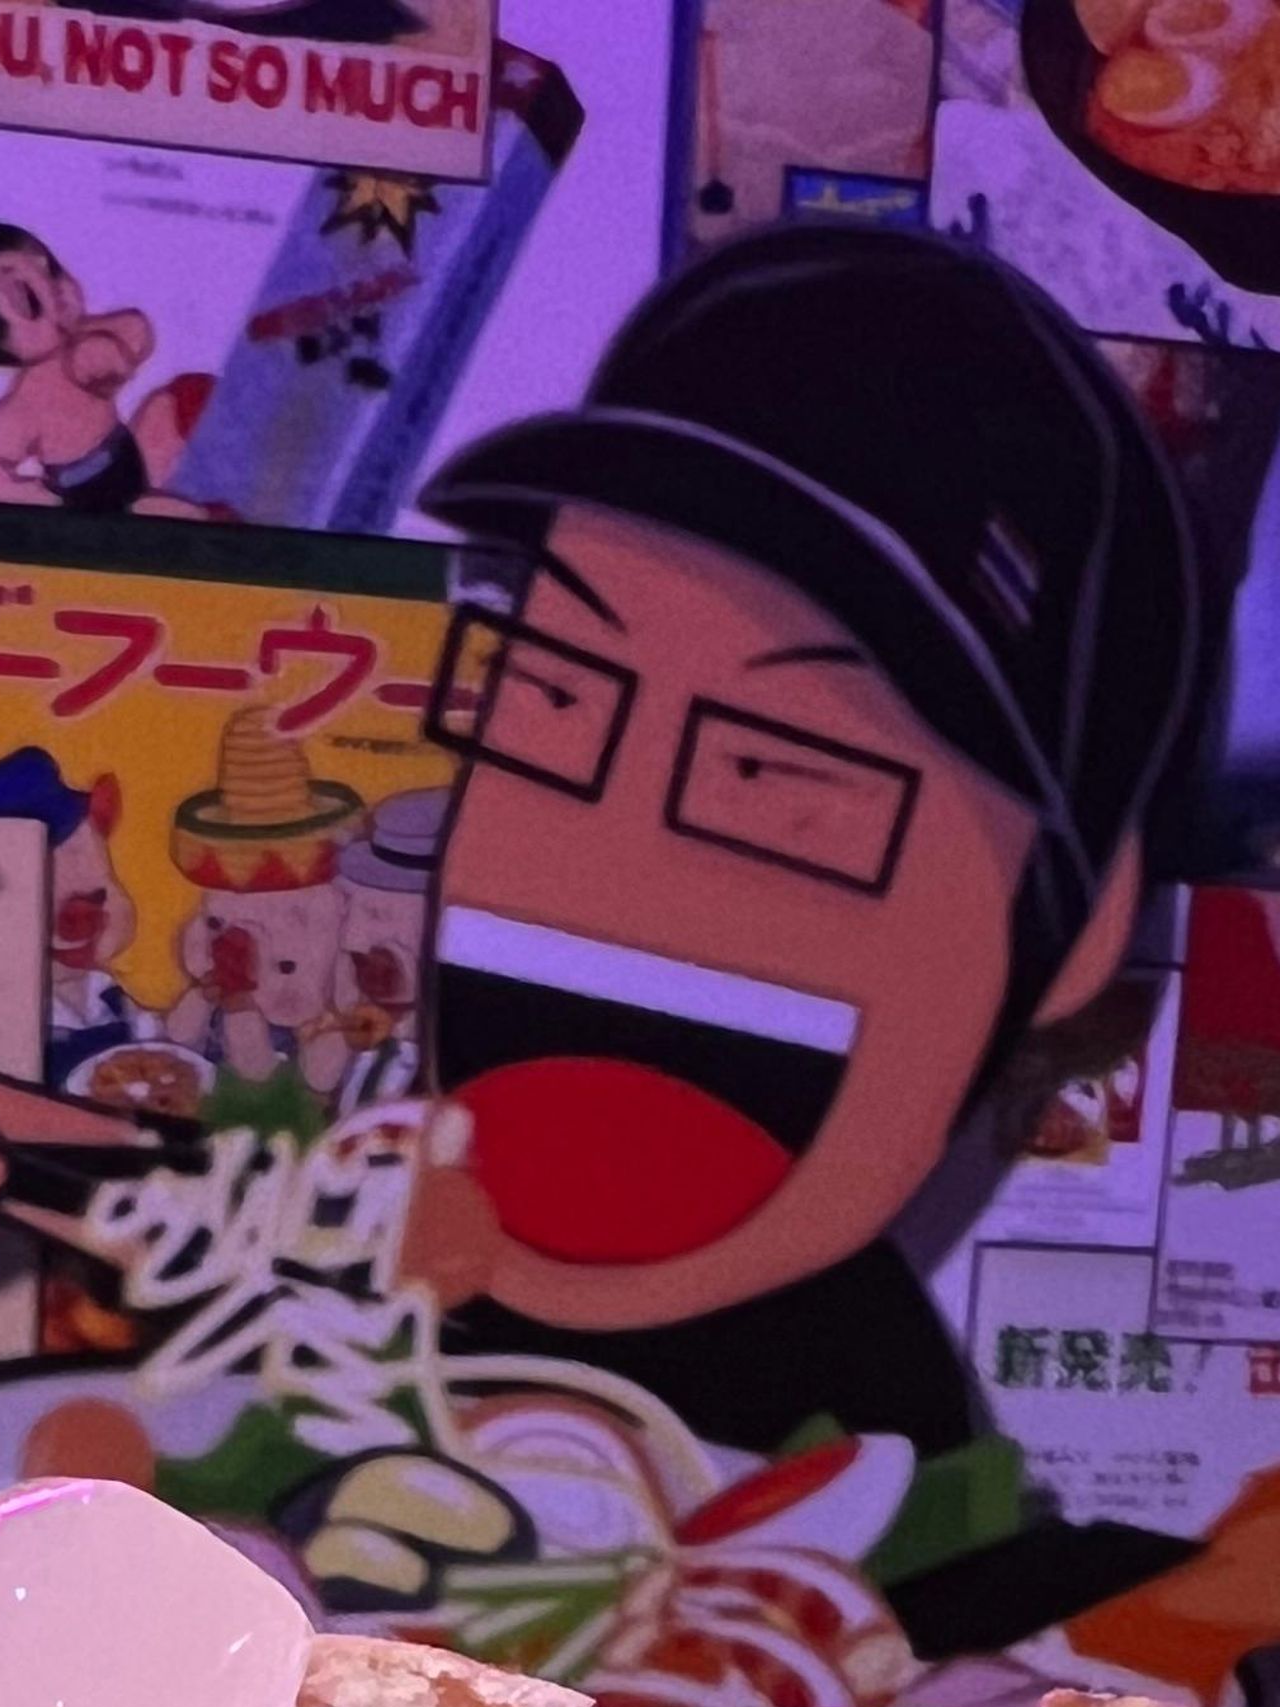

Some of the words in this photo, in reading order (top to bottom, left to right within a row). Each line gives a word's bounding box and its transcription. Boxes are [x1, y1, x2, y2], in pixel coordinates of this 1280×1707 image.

[63, 19, 194, 98] NOT
[206, 41, 289, 109] SO
[304, 50, 482, 133] MUCH
